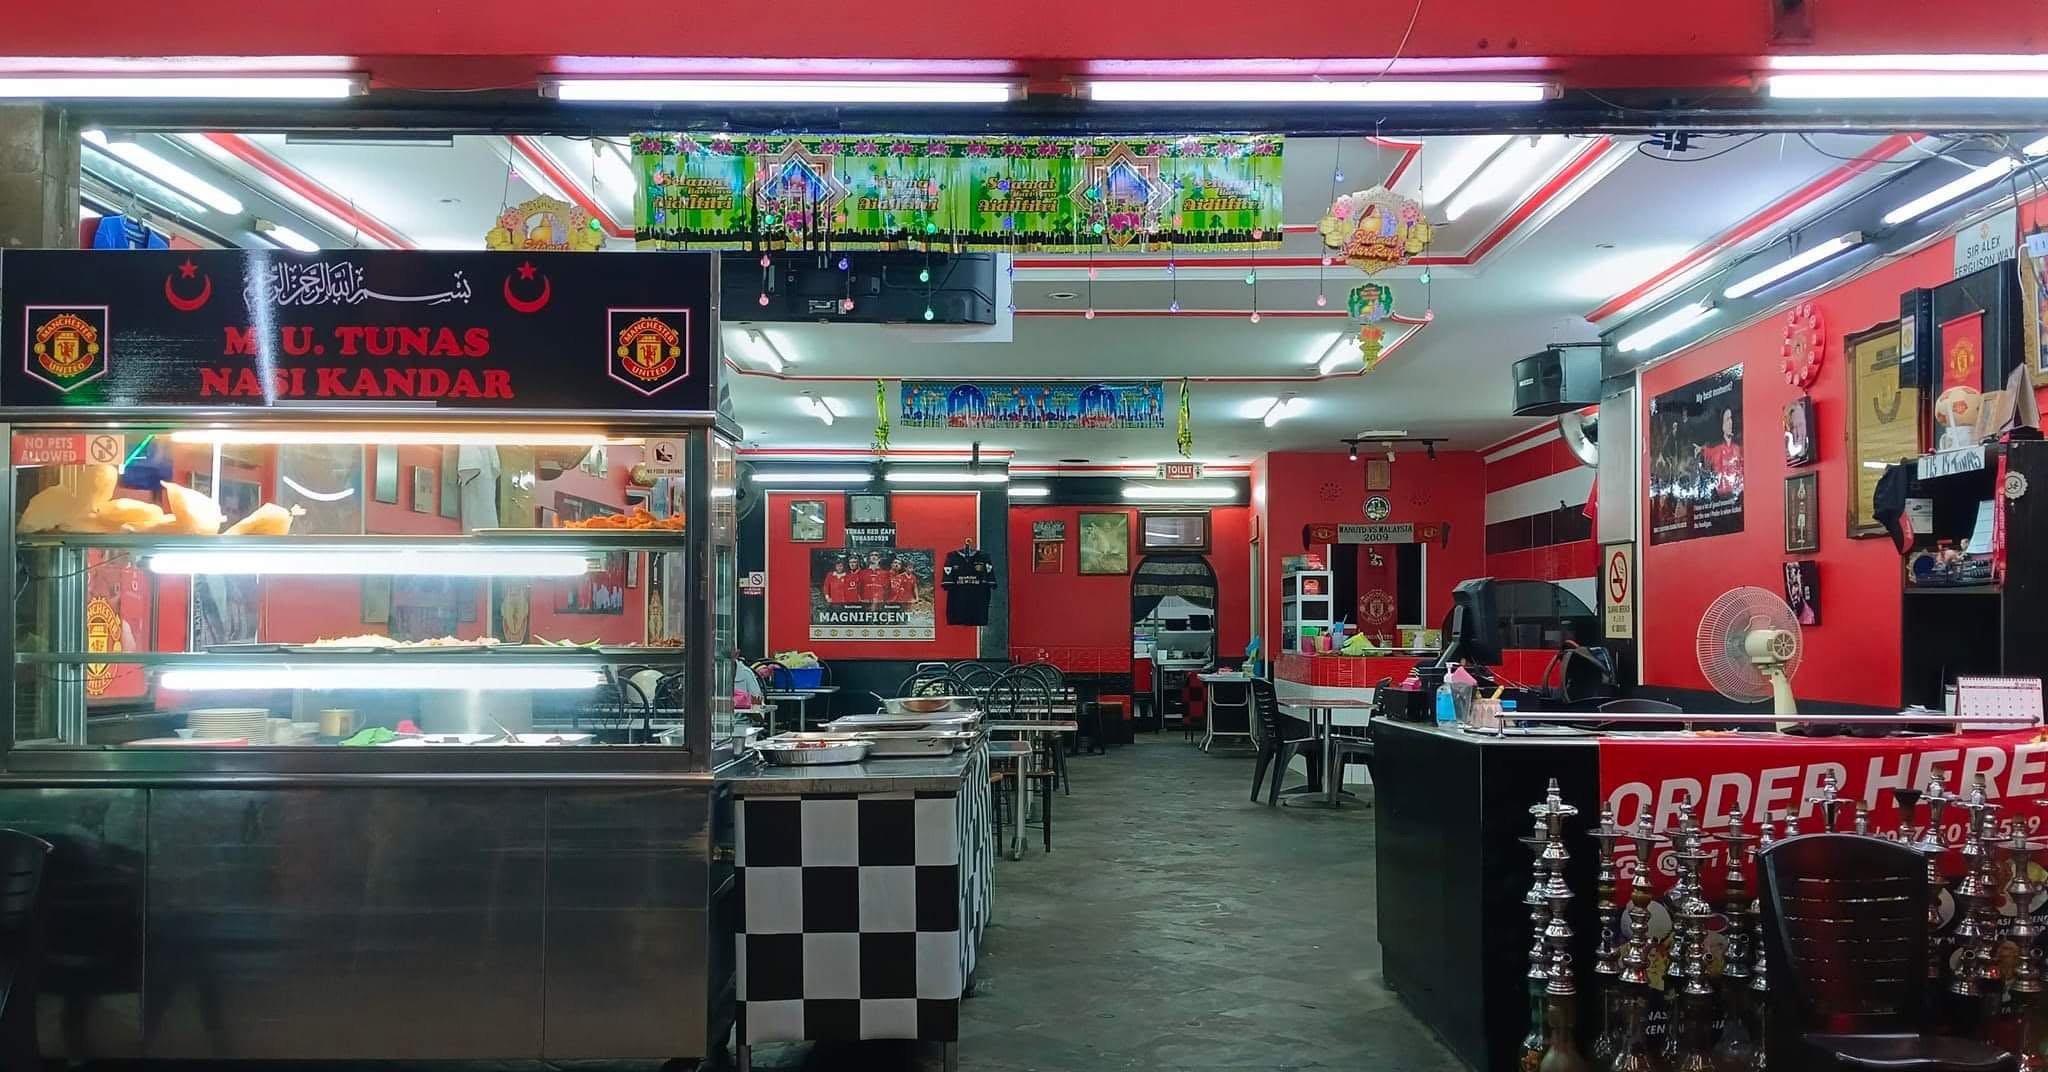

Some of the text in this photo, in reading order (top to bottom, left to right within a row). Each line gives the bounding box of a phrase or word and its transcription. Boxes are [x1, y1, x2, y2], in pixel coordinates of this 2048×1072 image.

[1967, 234, 2001, 259] SIR ALEX
[41, 318, 93, 342] MANCHESTER
[623, 320, 674, 343] MANCHESTER
[335, 327, 490, 356] TUNAS
[49, 361, 85, 375] UNITED
[632, 365, 668, 378] UNITED
[201, 368, 514, 398] NASI KANDAR
[25, 437, 73, 449] NO PETS
[21, 451, 77, 463] ALLOWED
[1168, 465, 1192, 474] TOILET
[1363, 533, 1389, 542] 2009
[820, 612, 911, 623] MAGNIFICENT
[1866, 745, 2048, 809] HERE
